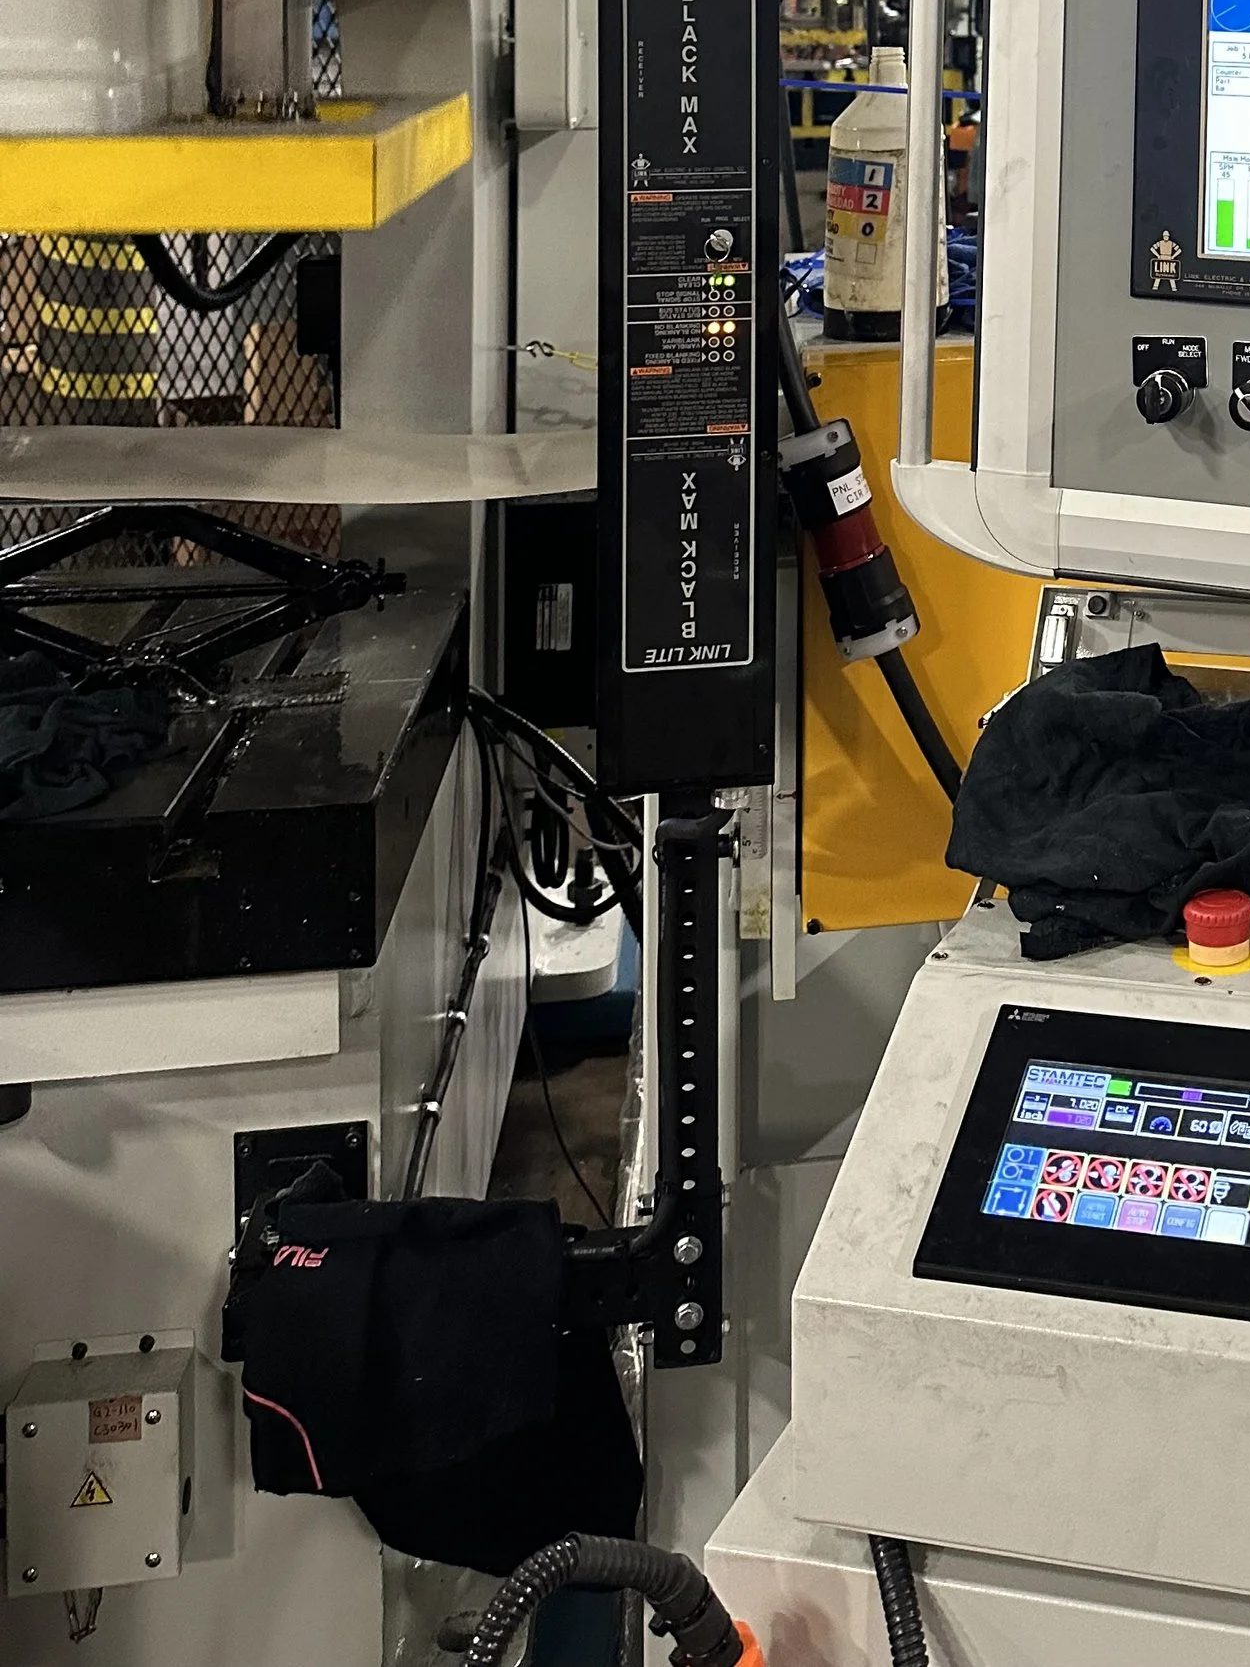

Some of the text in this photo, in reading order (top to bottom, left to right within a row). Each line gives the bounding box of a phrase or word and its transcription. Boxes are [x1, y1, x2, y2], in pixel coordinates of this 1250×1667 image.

[680, 96, 698, 153] MAX
[865, 193, 879, 210] 2
[1154, 261, 1176, 274] LINK
[1137, 343, 1150, 351] OFF
[1161, 338, 1175, 346] RUN
[1182, 344, 1200, 352] MODE
[832, 483, 852, 497] PNL
[846, 488, 864, 504] CIR
[680, 472, 698, 639] BLACK MAX
[643, 644, 731, 664] LINK LITE
[1028, 1068, 1107, 1089] STAMTEC
[1069, 1098, 1099, 1111] 7.020
[1020, 1110, 1043, 1122] inch
[1166, 1218, 1195, 1229] CONFIG
[273, 1245, 330, 1268] FILA
